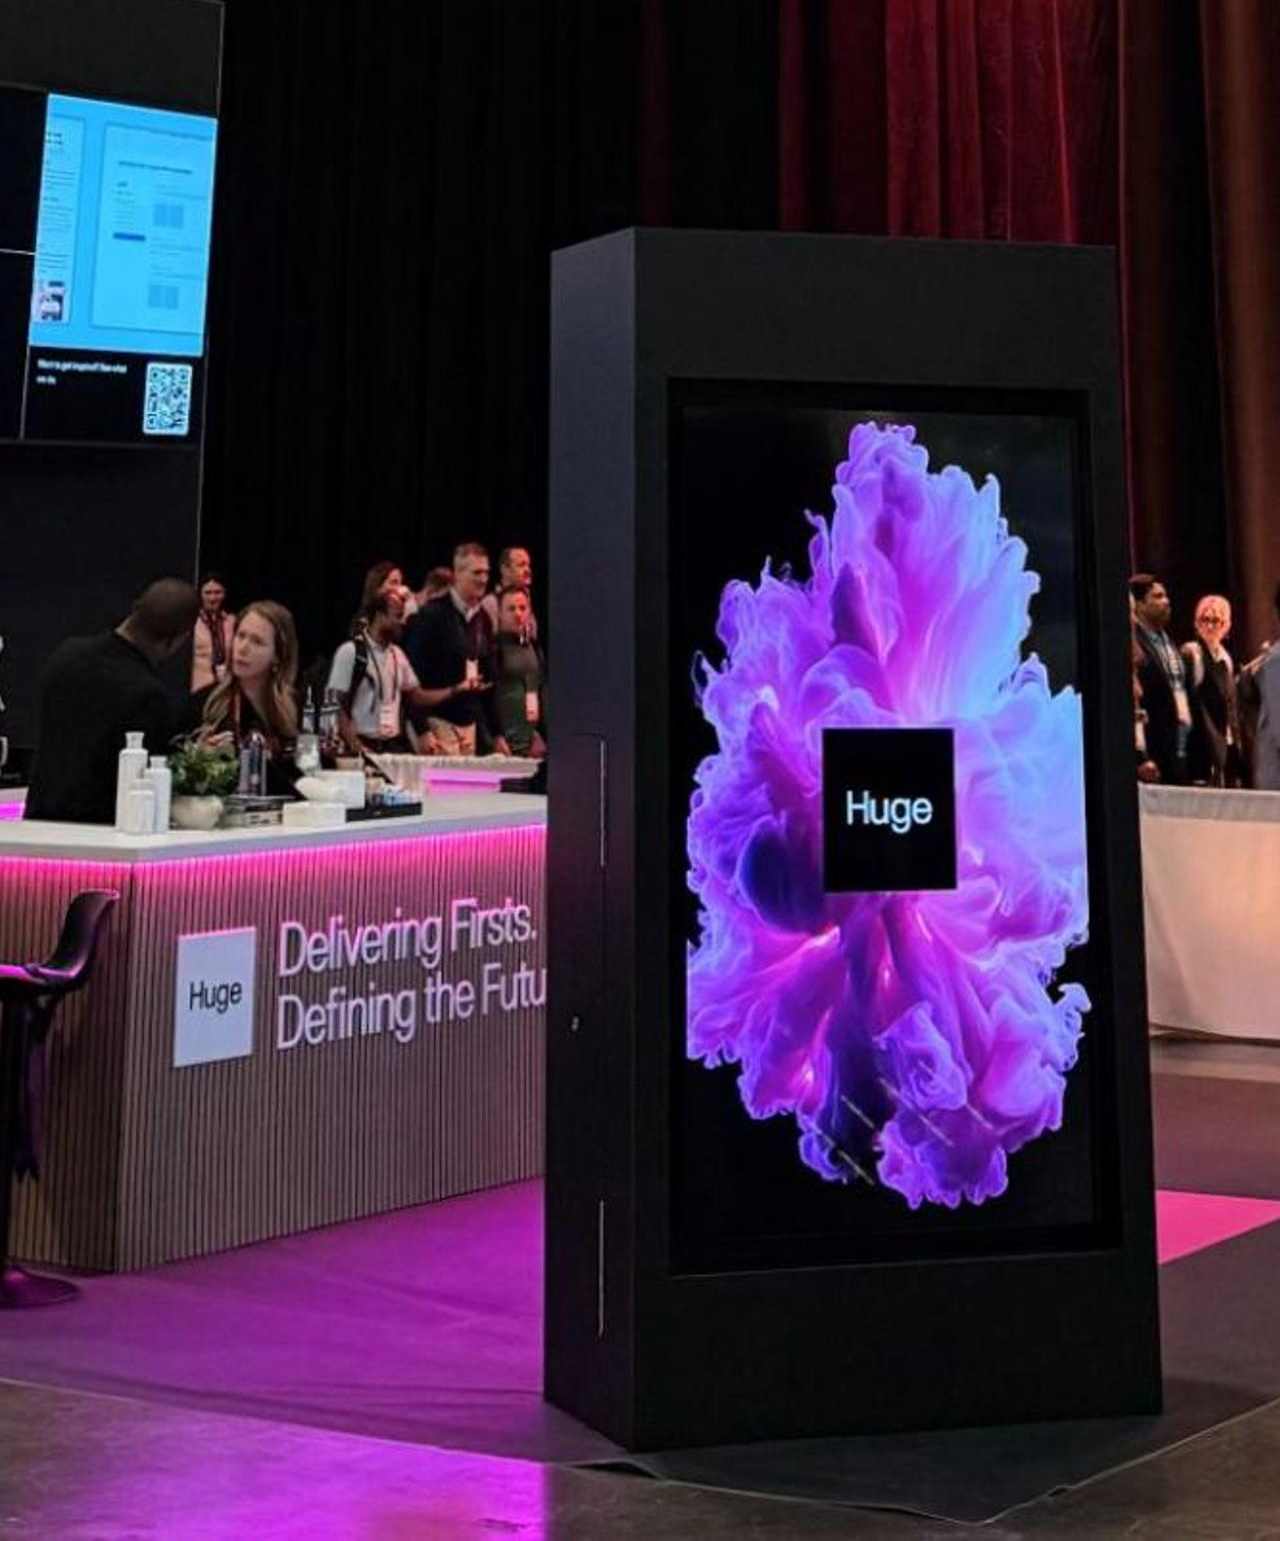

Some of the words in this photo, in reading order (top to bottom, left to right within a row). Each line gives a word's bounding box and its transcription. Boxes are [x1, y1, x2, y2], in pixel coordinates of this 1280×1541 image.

[846, 789, 933, 834] Huge
[278, 907, 442, 977] Delivering
[450, 897, 538, 952] Firsts.
[188, 979, 243, 1015] Huge
[276, 979, 417, 1050] Defining
[424, 970, 475, 1024] the
[482, 962, 547, 1015] Futu
